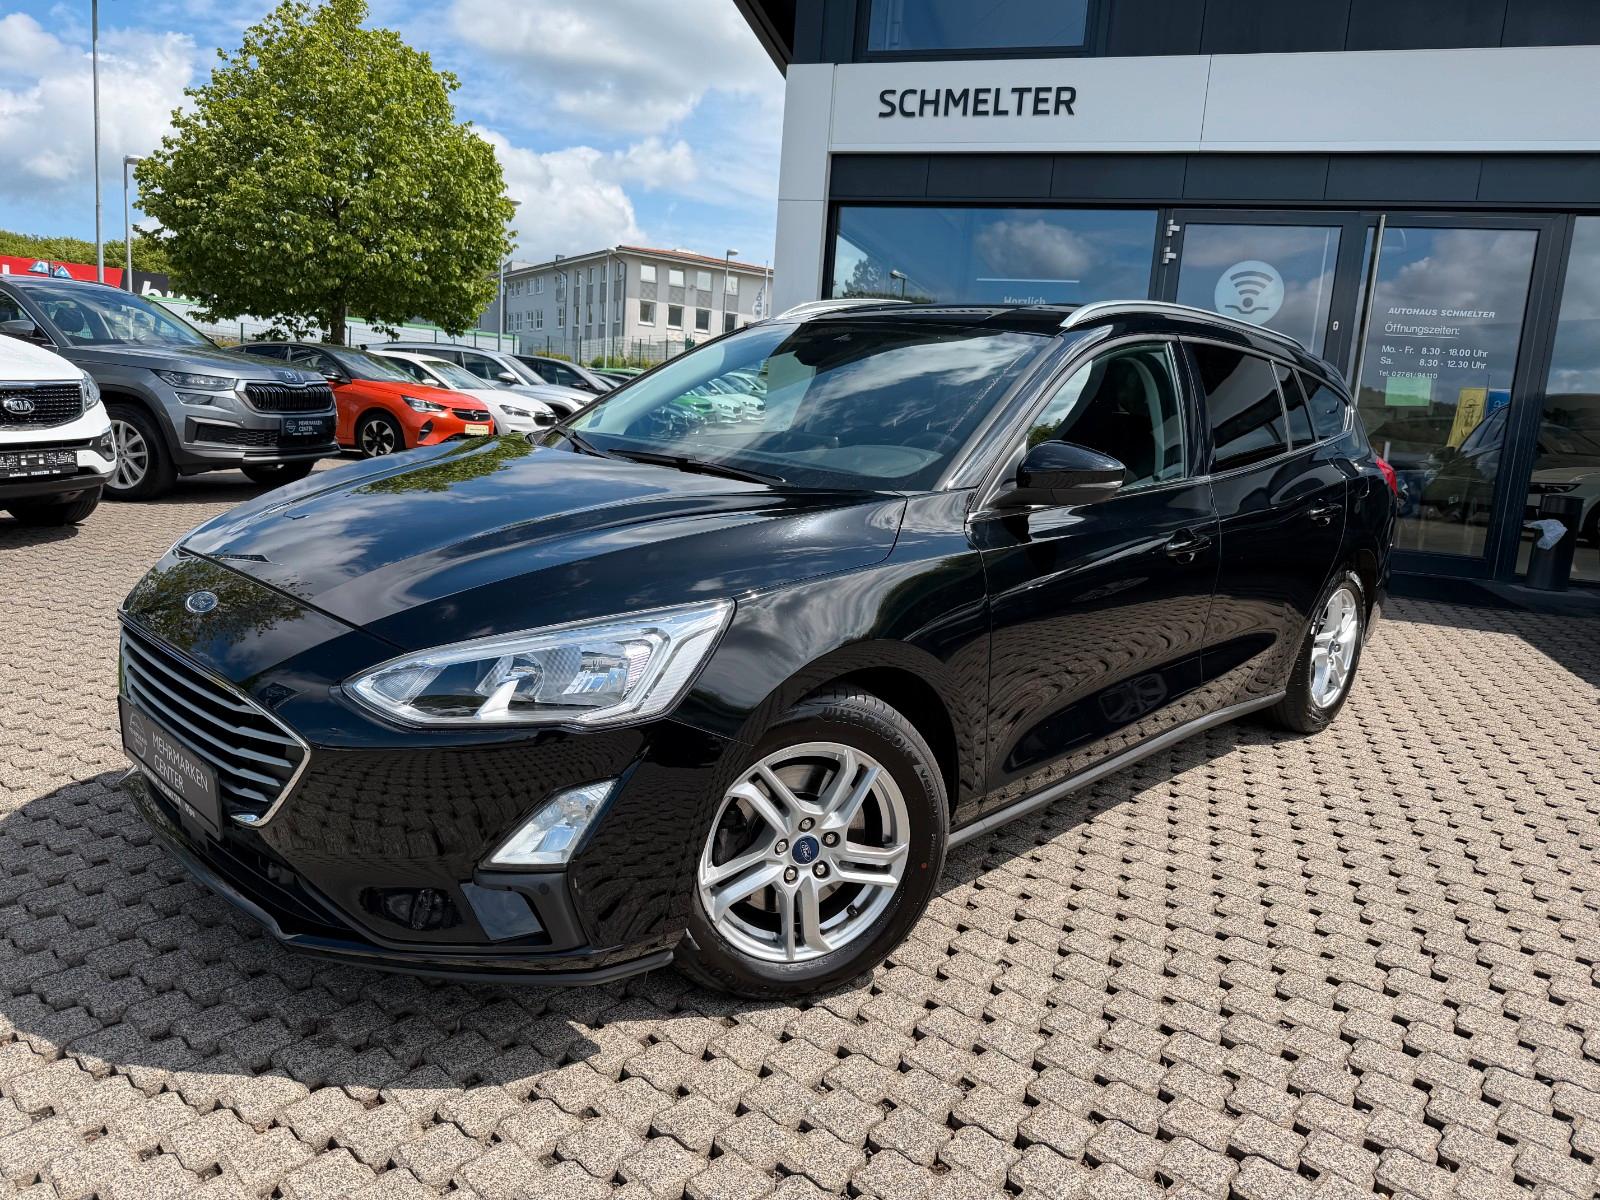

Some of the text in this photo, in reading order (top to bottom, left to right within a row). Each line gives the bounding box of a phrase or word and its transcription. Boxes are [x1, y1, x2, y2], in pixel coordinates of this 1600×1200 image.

[878, 86, 1078, 118] SCHMELTER
[1387, 307, 1496, 319] AUTOHAUS SCHMELTER
[1384, 321, 1460, 336] Öffnungszeiten:
[1381, 345, 1396, 353] Mo.
[1404, 346, 1415, 354] Fr.
[1421, 347, 1440, 355] 8.30
[1448, 348, 1471, 357] 18.00
[1473, 349, 1489, 358] Uhr
[1380, 356, 1394, 364] Sa.
[1419, 359, 1438, 367] 8.30
[1447, 360, 1469, 368] 12.30
[1471, 361, 1487, 369] Uhr
[11, 401, 31, 410] KIA
[152, 731, 209, 793] MEHRMARKEN
[154, 754, 186, 795] CENTER
